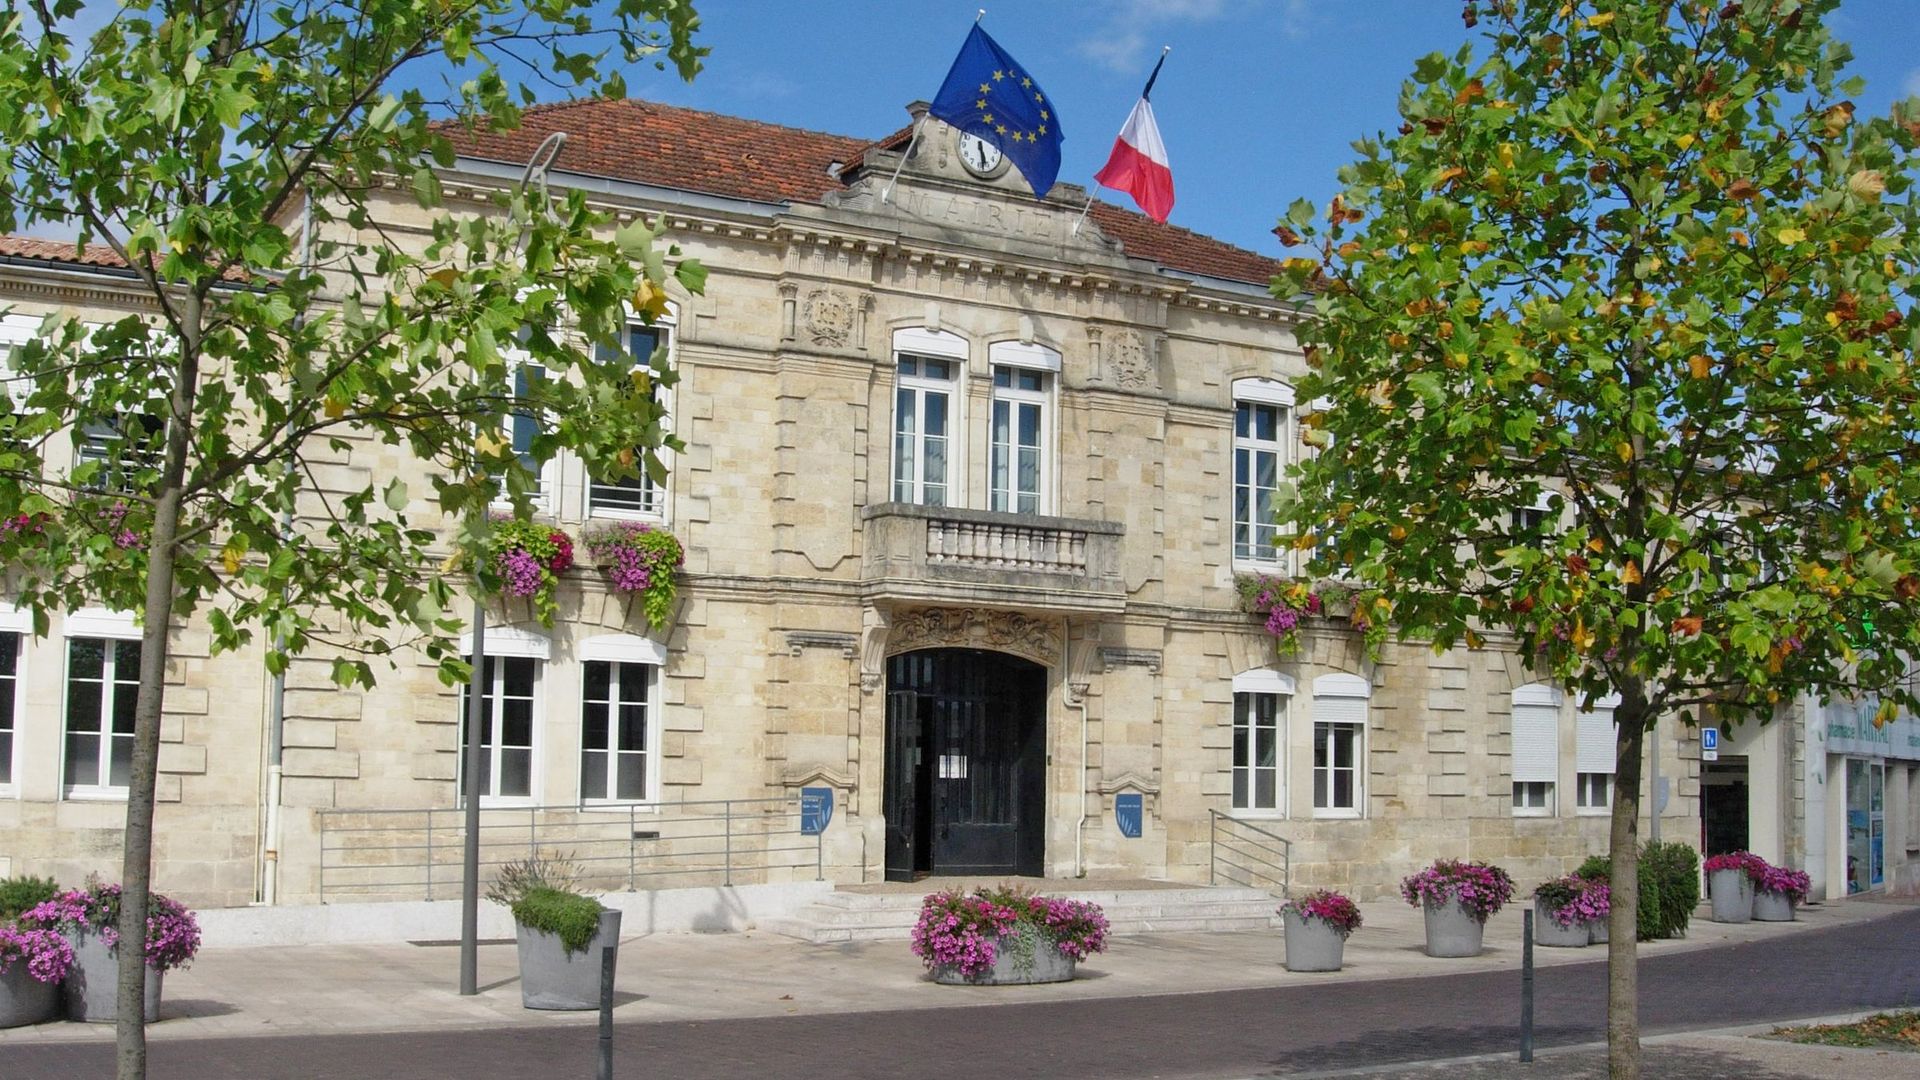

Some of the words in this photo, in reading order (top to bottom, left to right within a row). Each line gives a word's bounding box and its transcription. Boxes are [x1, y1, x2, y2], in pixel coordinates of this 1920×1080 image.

[961, 141, 967, 149] 9
[969, 157, 975, 165] 7
[907, 189, 1052, 238] MAIRIE
